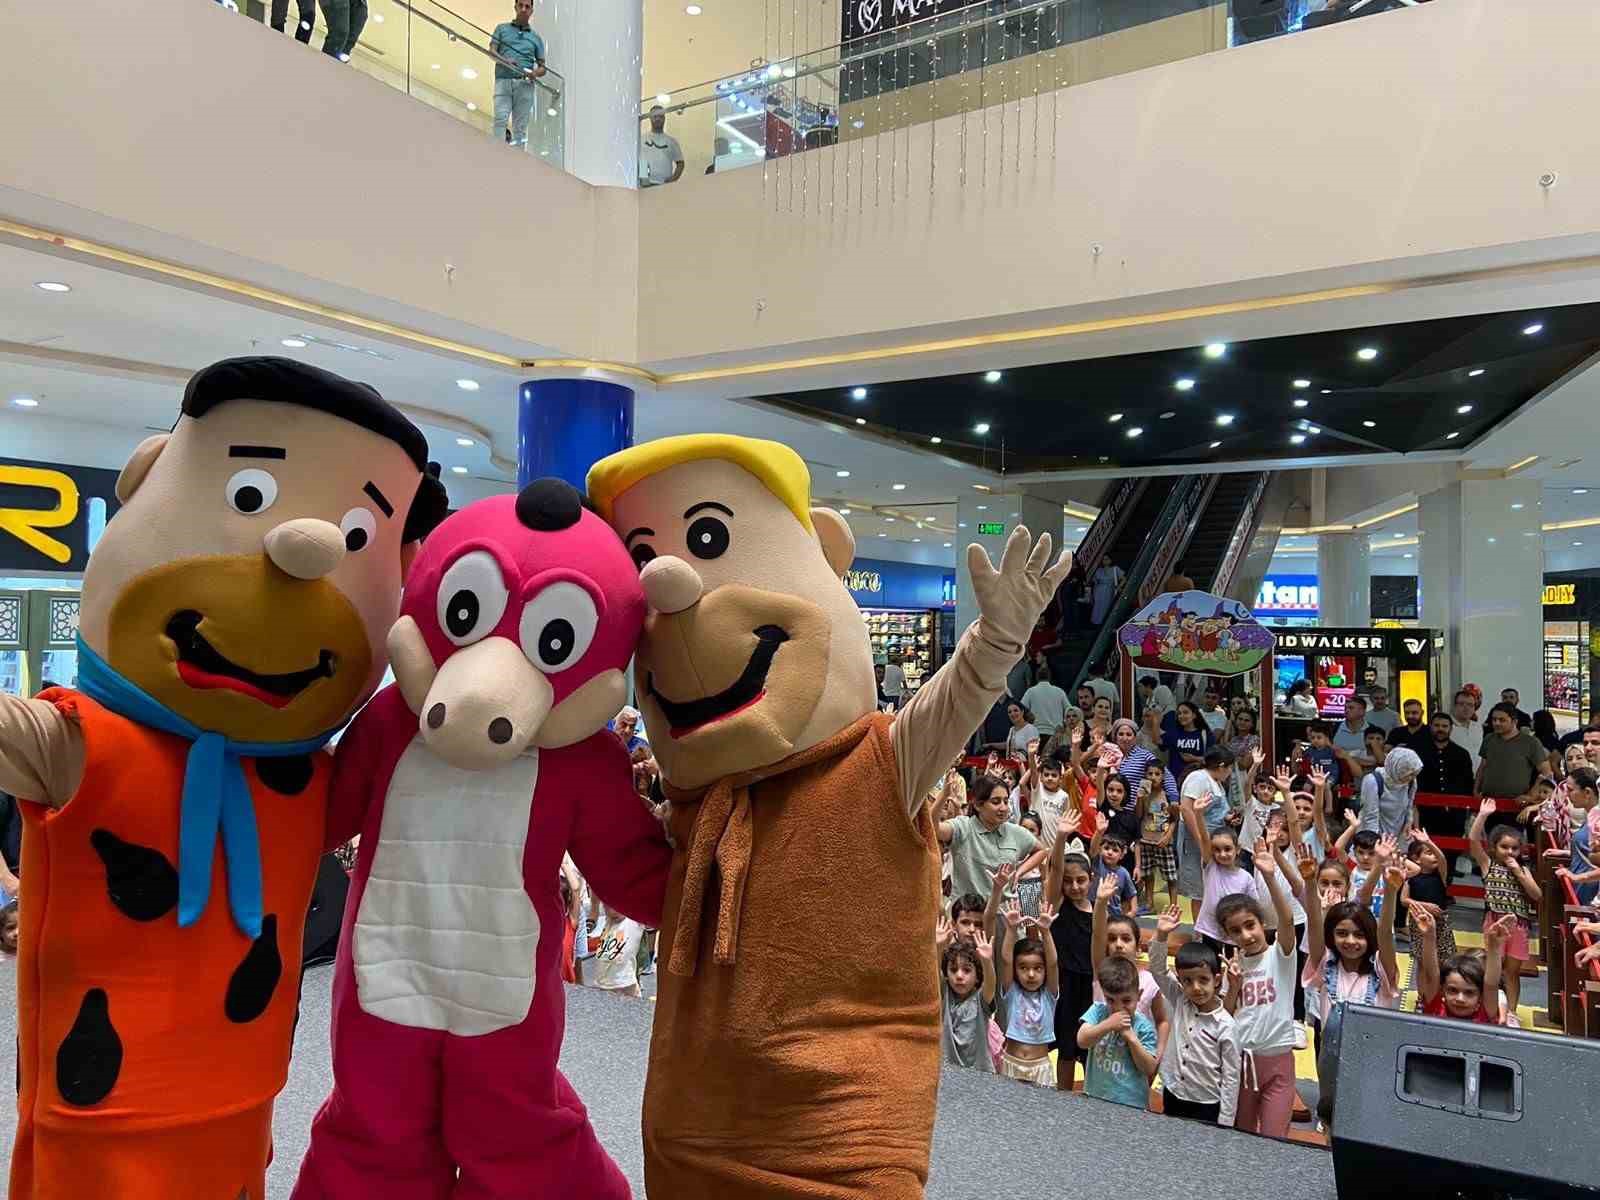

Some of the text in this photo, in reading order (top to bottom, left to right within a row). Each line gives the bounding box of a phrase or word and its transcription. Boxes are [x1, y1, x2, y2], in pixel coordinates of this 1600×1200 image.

[1541, 584, 1575, 605] DIY
[1275, 635, 1382, 649] ID WALKER
[1240, 977, 1277, 1006] BES
